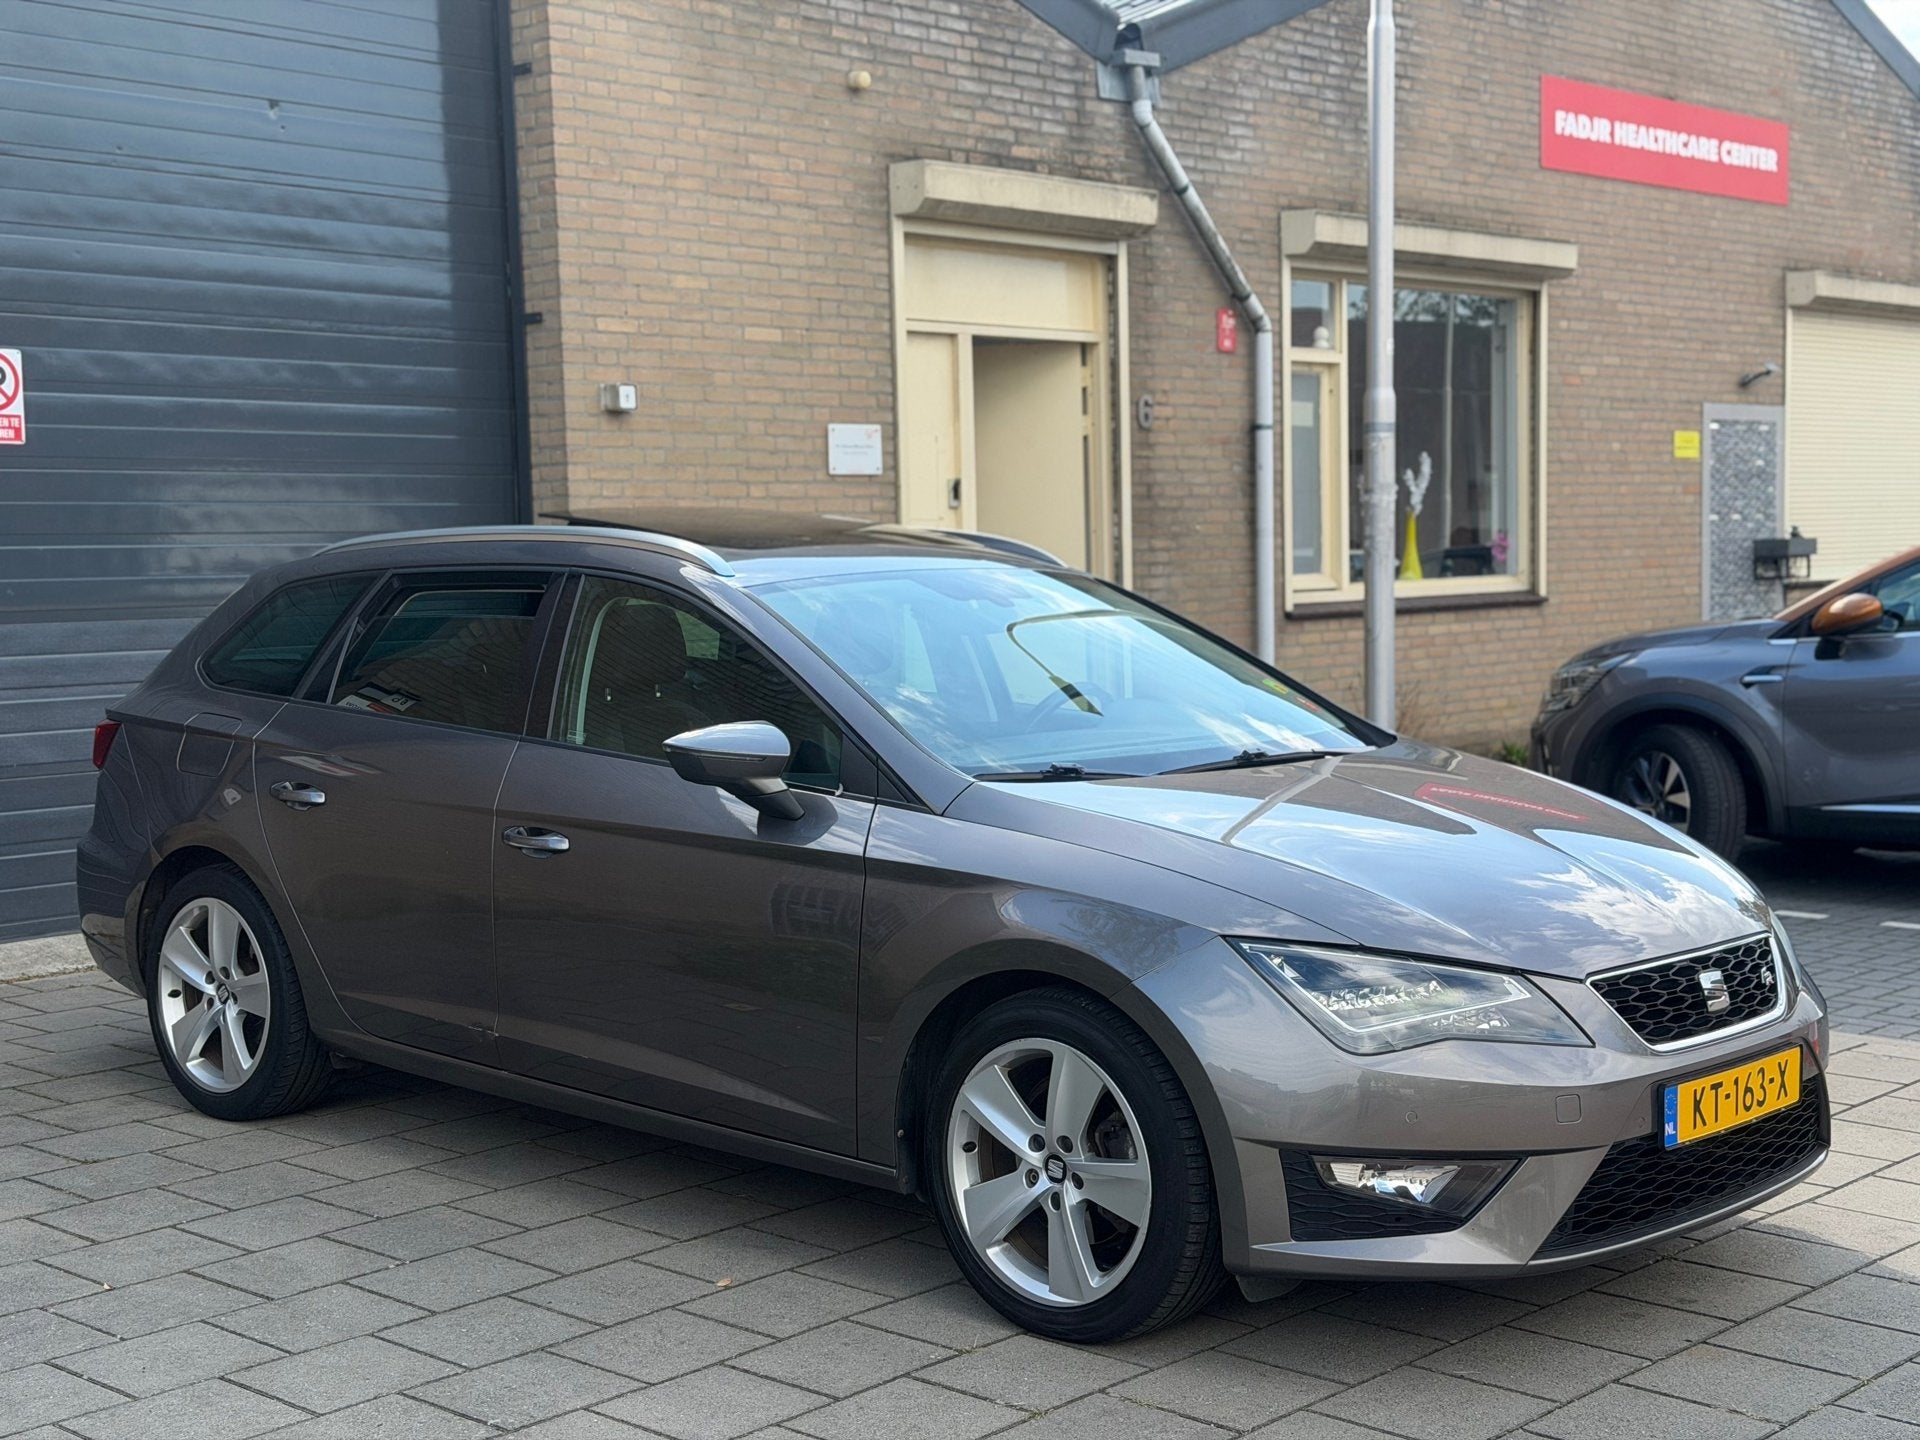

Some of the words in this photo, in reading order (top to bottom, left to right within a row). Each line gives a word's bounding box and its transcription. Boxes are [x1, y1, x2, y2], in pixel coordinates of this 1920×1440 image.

[1554, 109, 1612, 144] FADJR
[1613, 120, 1719, 163] HEALTHCARE
[1720, 140, 1778, 172] CENTER
[10, 417, 21, 429] TE
[1138, 394, 1153, 429] 6
[1692, 1058, 1789, 1130] KT-163-X
[1664, 1121, 1676, 1136] NL
